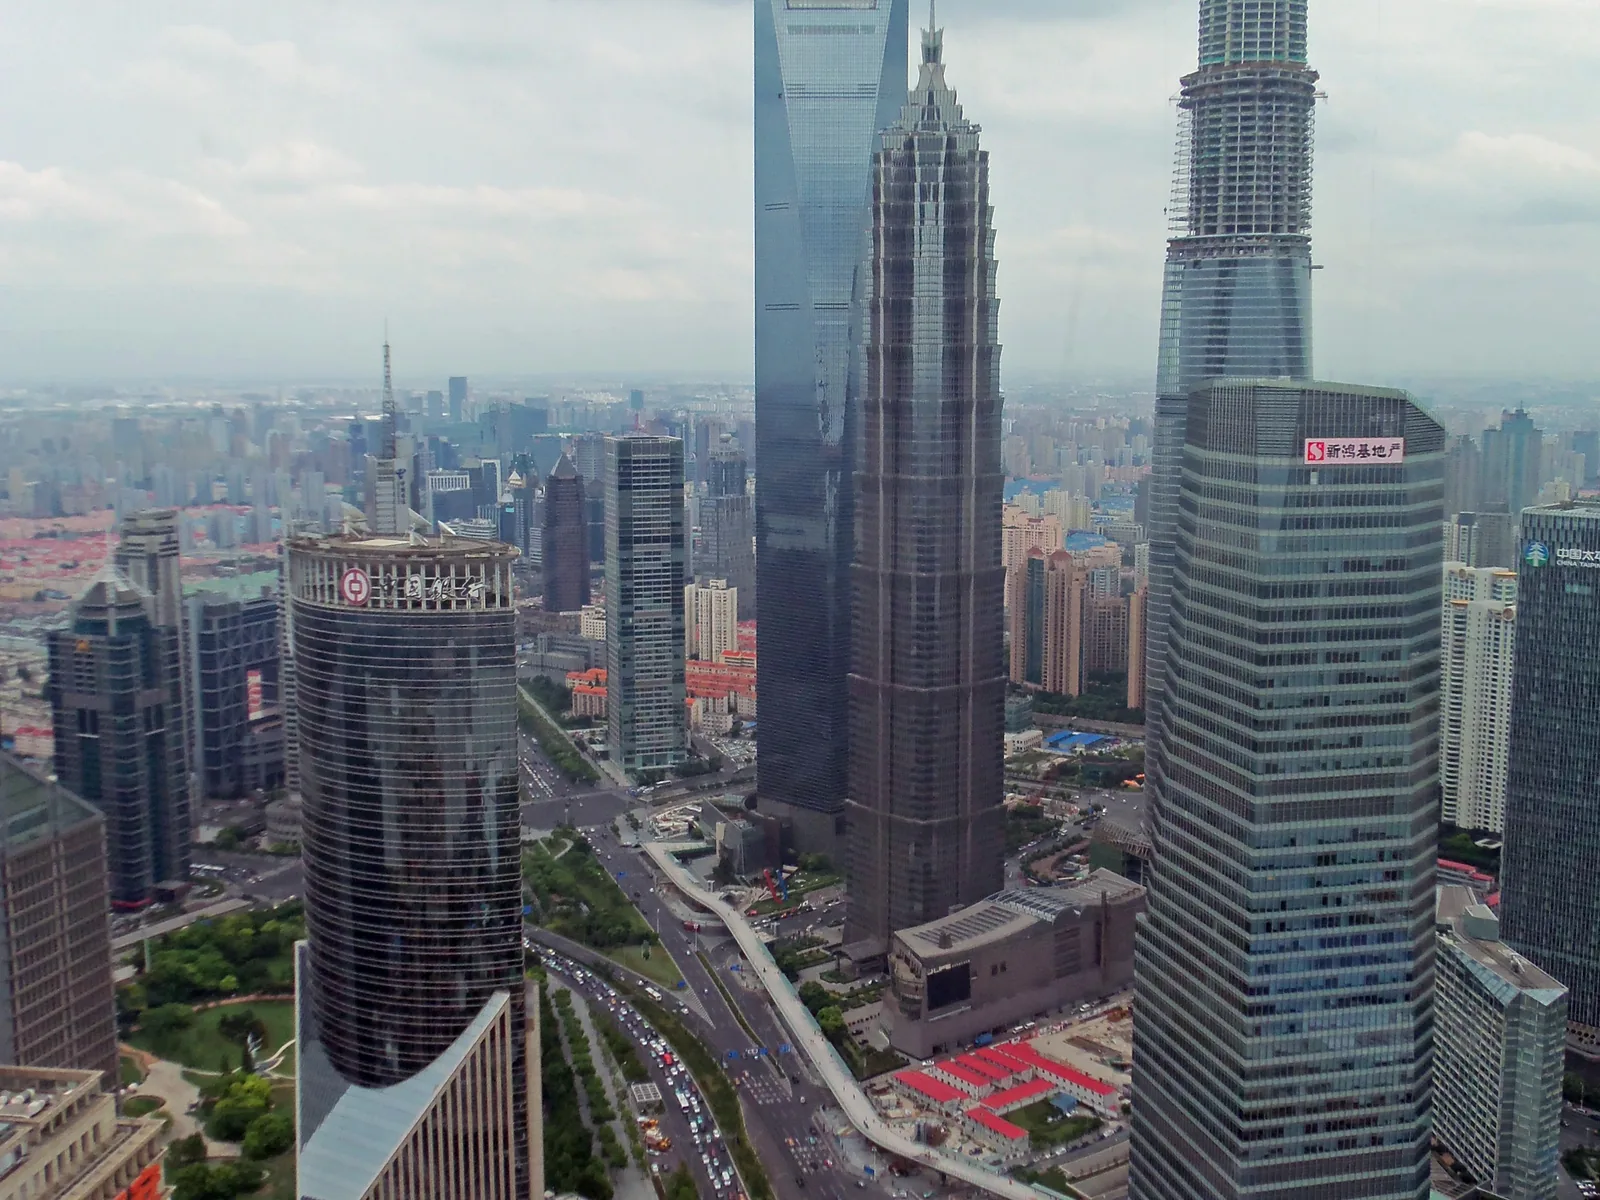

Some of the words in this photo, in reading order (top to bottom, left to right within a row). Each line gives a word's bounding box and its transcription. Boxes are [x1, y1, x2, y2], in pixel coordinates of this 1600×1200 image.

[1326, 443, 1401, 459] 新鸿基地产
[382, 574, 486, 602] 中国银行
